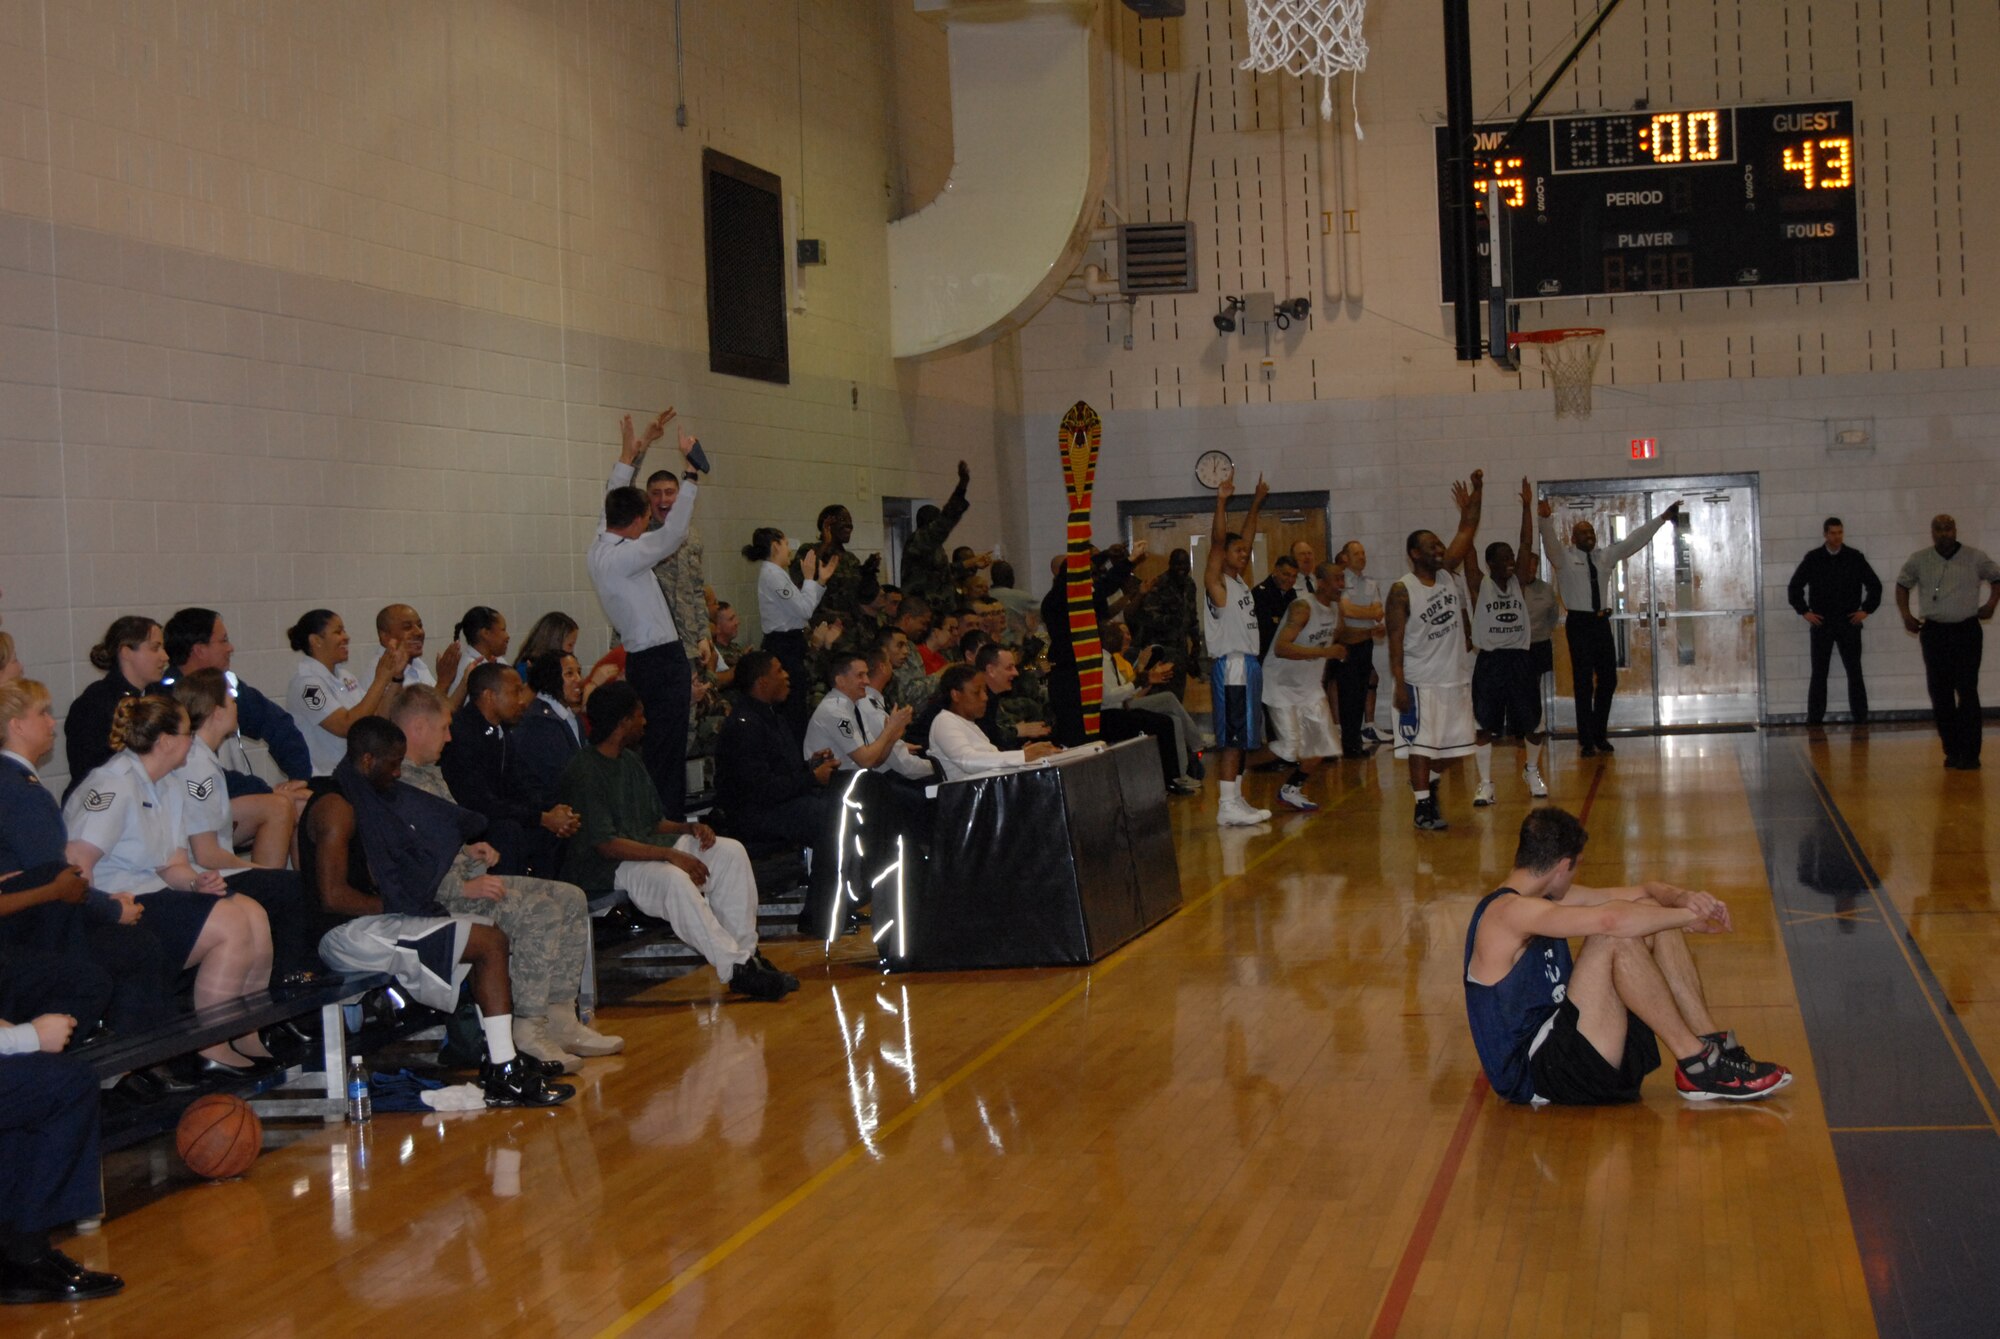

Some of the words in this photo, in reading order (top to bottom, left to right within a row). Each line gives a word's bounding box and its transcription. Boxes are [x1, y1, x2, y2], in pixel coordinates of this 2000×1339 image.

[1773, 111, 1840, 133] GUEST
[1782, 138, 1852, 191] 43
[1744, 164, 1754, 199] POSS
[1535, 176, 1546, 212] POSS
[1606, 191, 1664, 207] PERIOD
[1618, 232, 1674, 249] PLAYER
[1786, 222, 1836, 239] FOULS
[1632, 439, 1655, 458] EXIT
[1420, 600, 1443, 624] POPE
[1486, 601, 1512, 613] POPE
